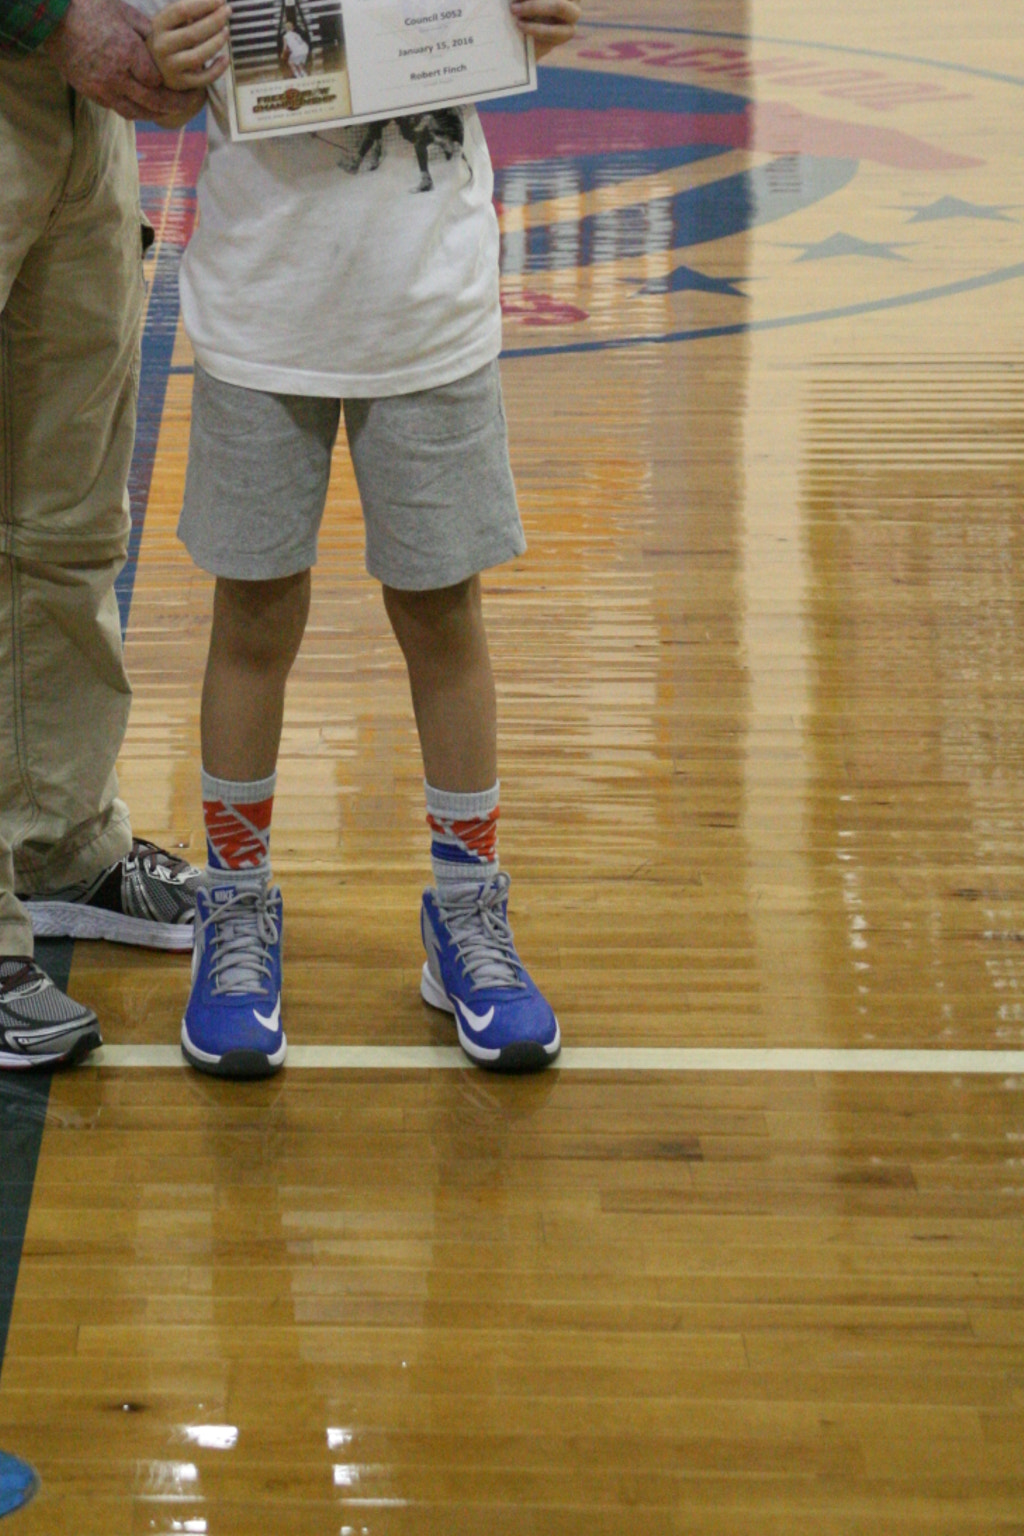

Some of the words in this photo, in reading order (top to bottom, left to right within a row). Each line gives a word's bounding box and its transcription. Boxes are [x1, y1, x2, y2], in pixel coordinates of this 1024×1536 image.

[404, 12, 438, 26] Council
[440, 9, 463, 20] 5052
[398, 45, 434, 57] January
[452, 36, 474, 47] 2016
[410, 68, 441, 80] Robert
[443, 64, 467, 74] Finch
[214, 888, 235, 902] NIKE
